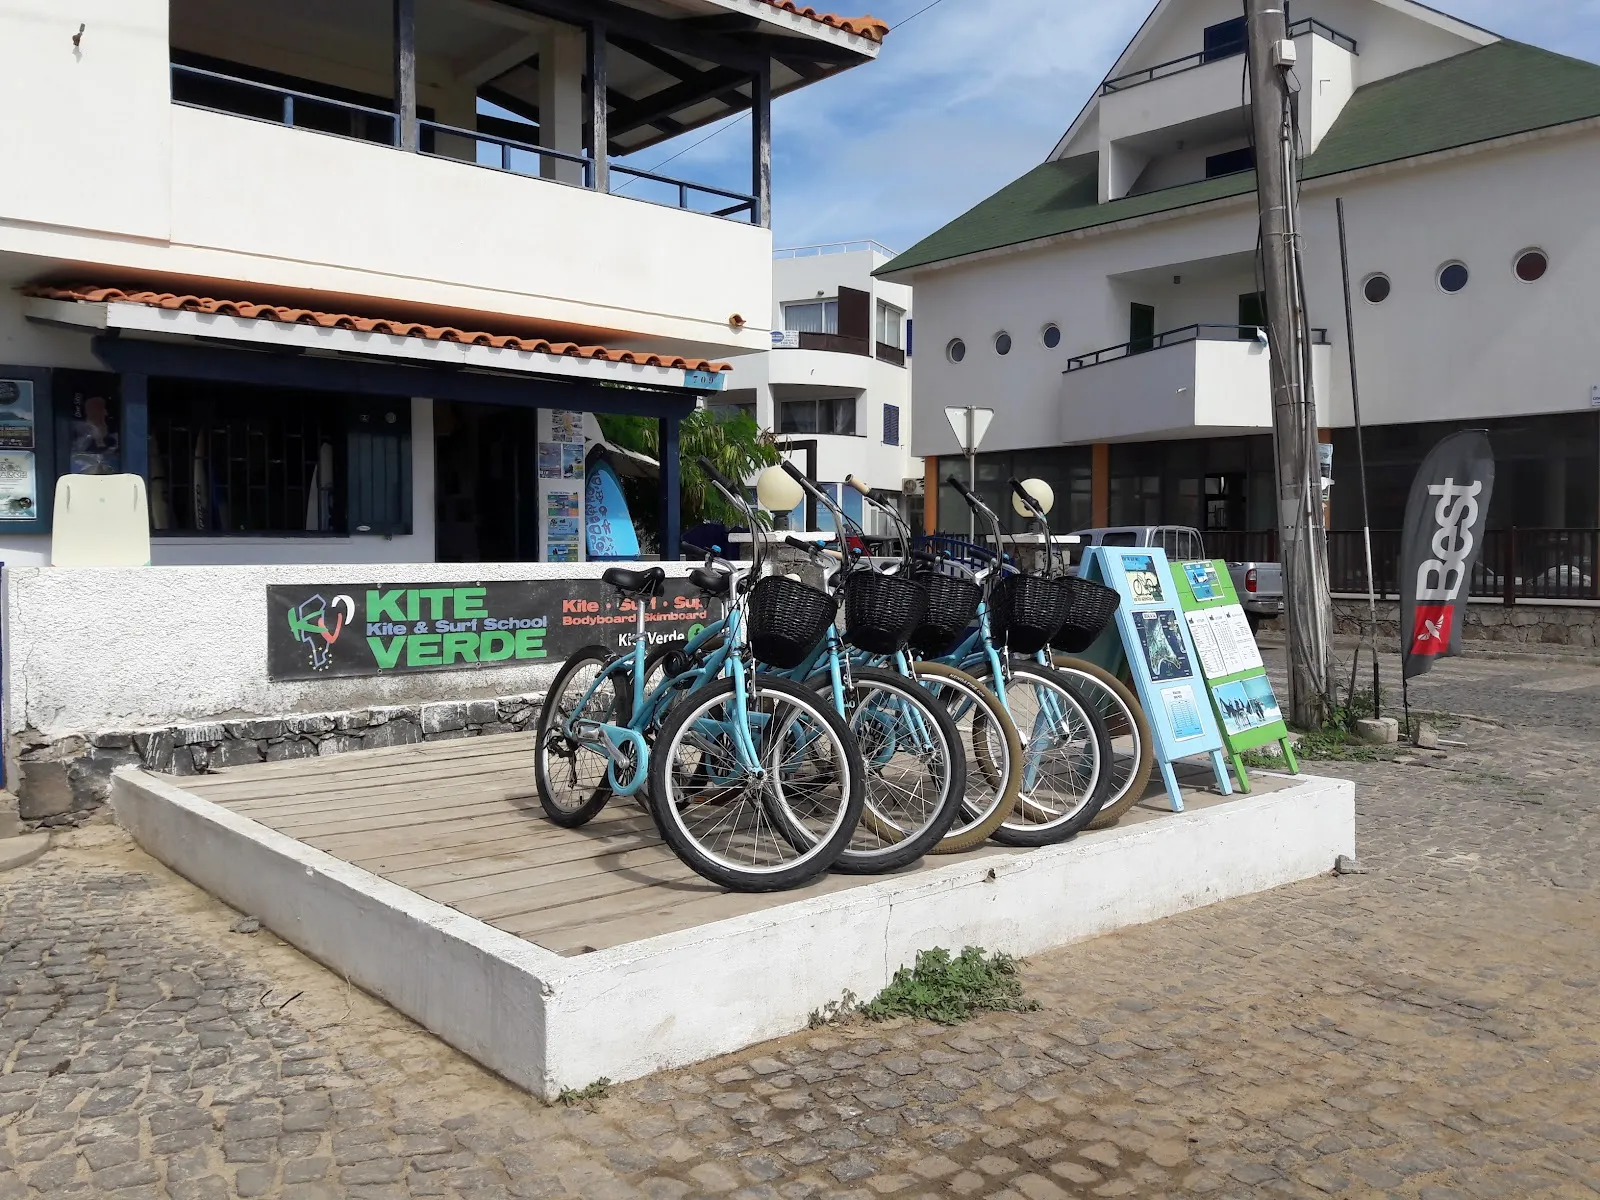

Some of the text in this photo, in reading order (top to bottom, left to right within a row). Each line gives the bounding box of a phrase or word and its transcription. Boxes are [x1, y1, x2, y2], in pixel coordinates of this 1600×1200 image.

[1416, 478, 1482, 601] Best
[366, 587, 489, 622] KITE
[619, 596, 657, 611] Suf
[366, 615, 547, 636] Kite & Surf School
[562, 610, 707, 626] Bodyboard Skimboard
[647, 630, 685, 645] Verde
[366, 628, 547, 669] VERDE
